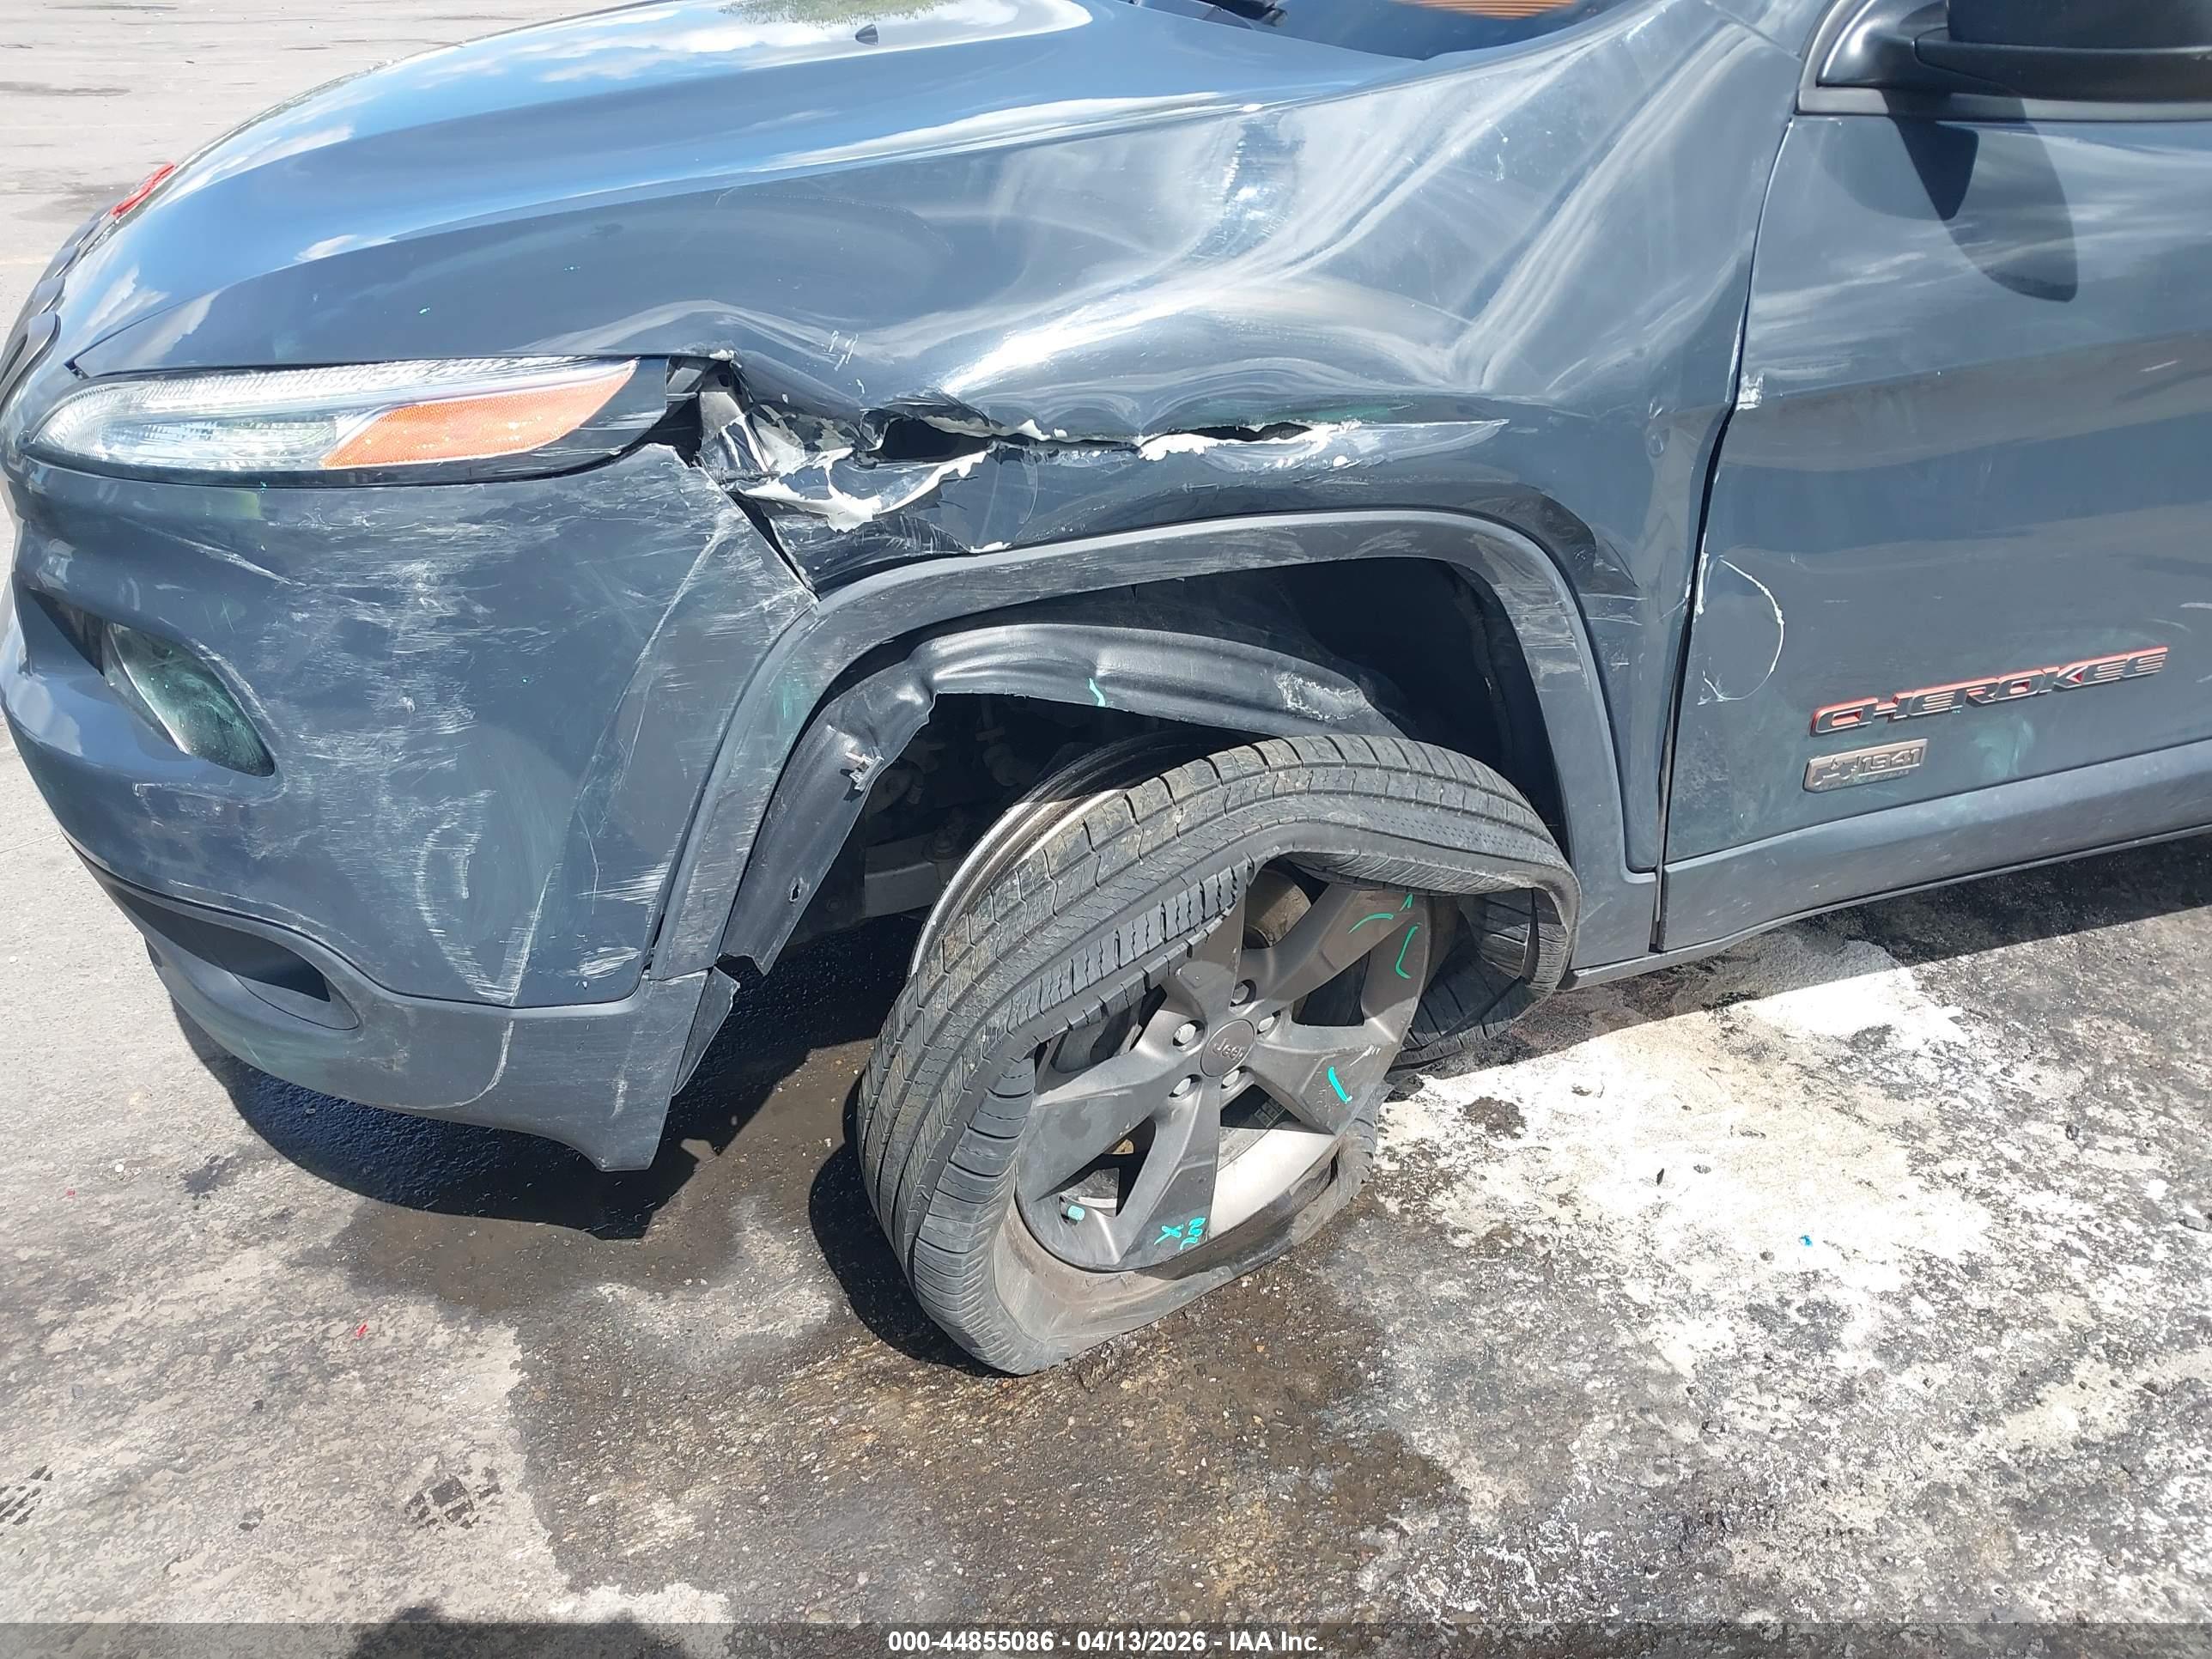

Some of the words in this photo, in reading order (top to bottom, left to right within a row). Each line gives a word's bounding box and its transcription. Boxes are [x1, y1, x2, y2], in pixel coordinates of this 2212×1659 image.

[1809, 647, 2168, 737] CHEROKEE
[1862, 747, 1921, 773] 1941
[1211, 1037, 1245, 1062] Jeep
